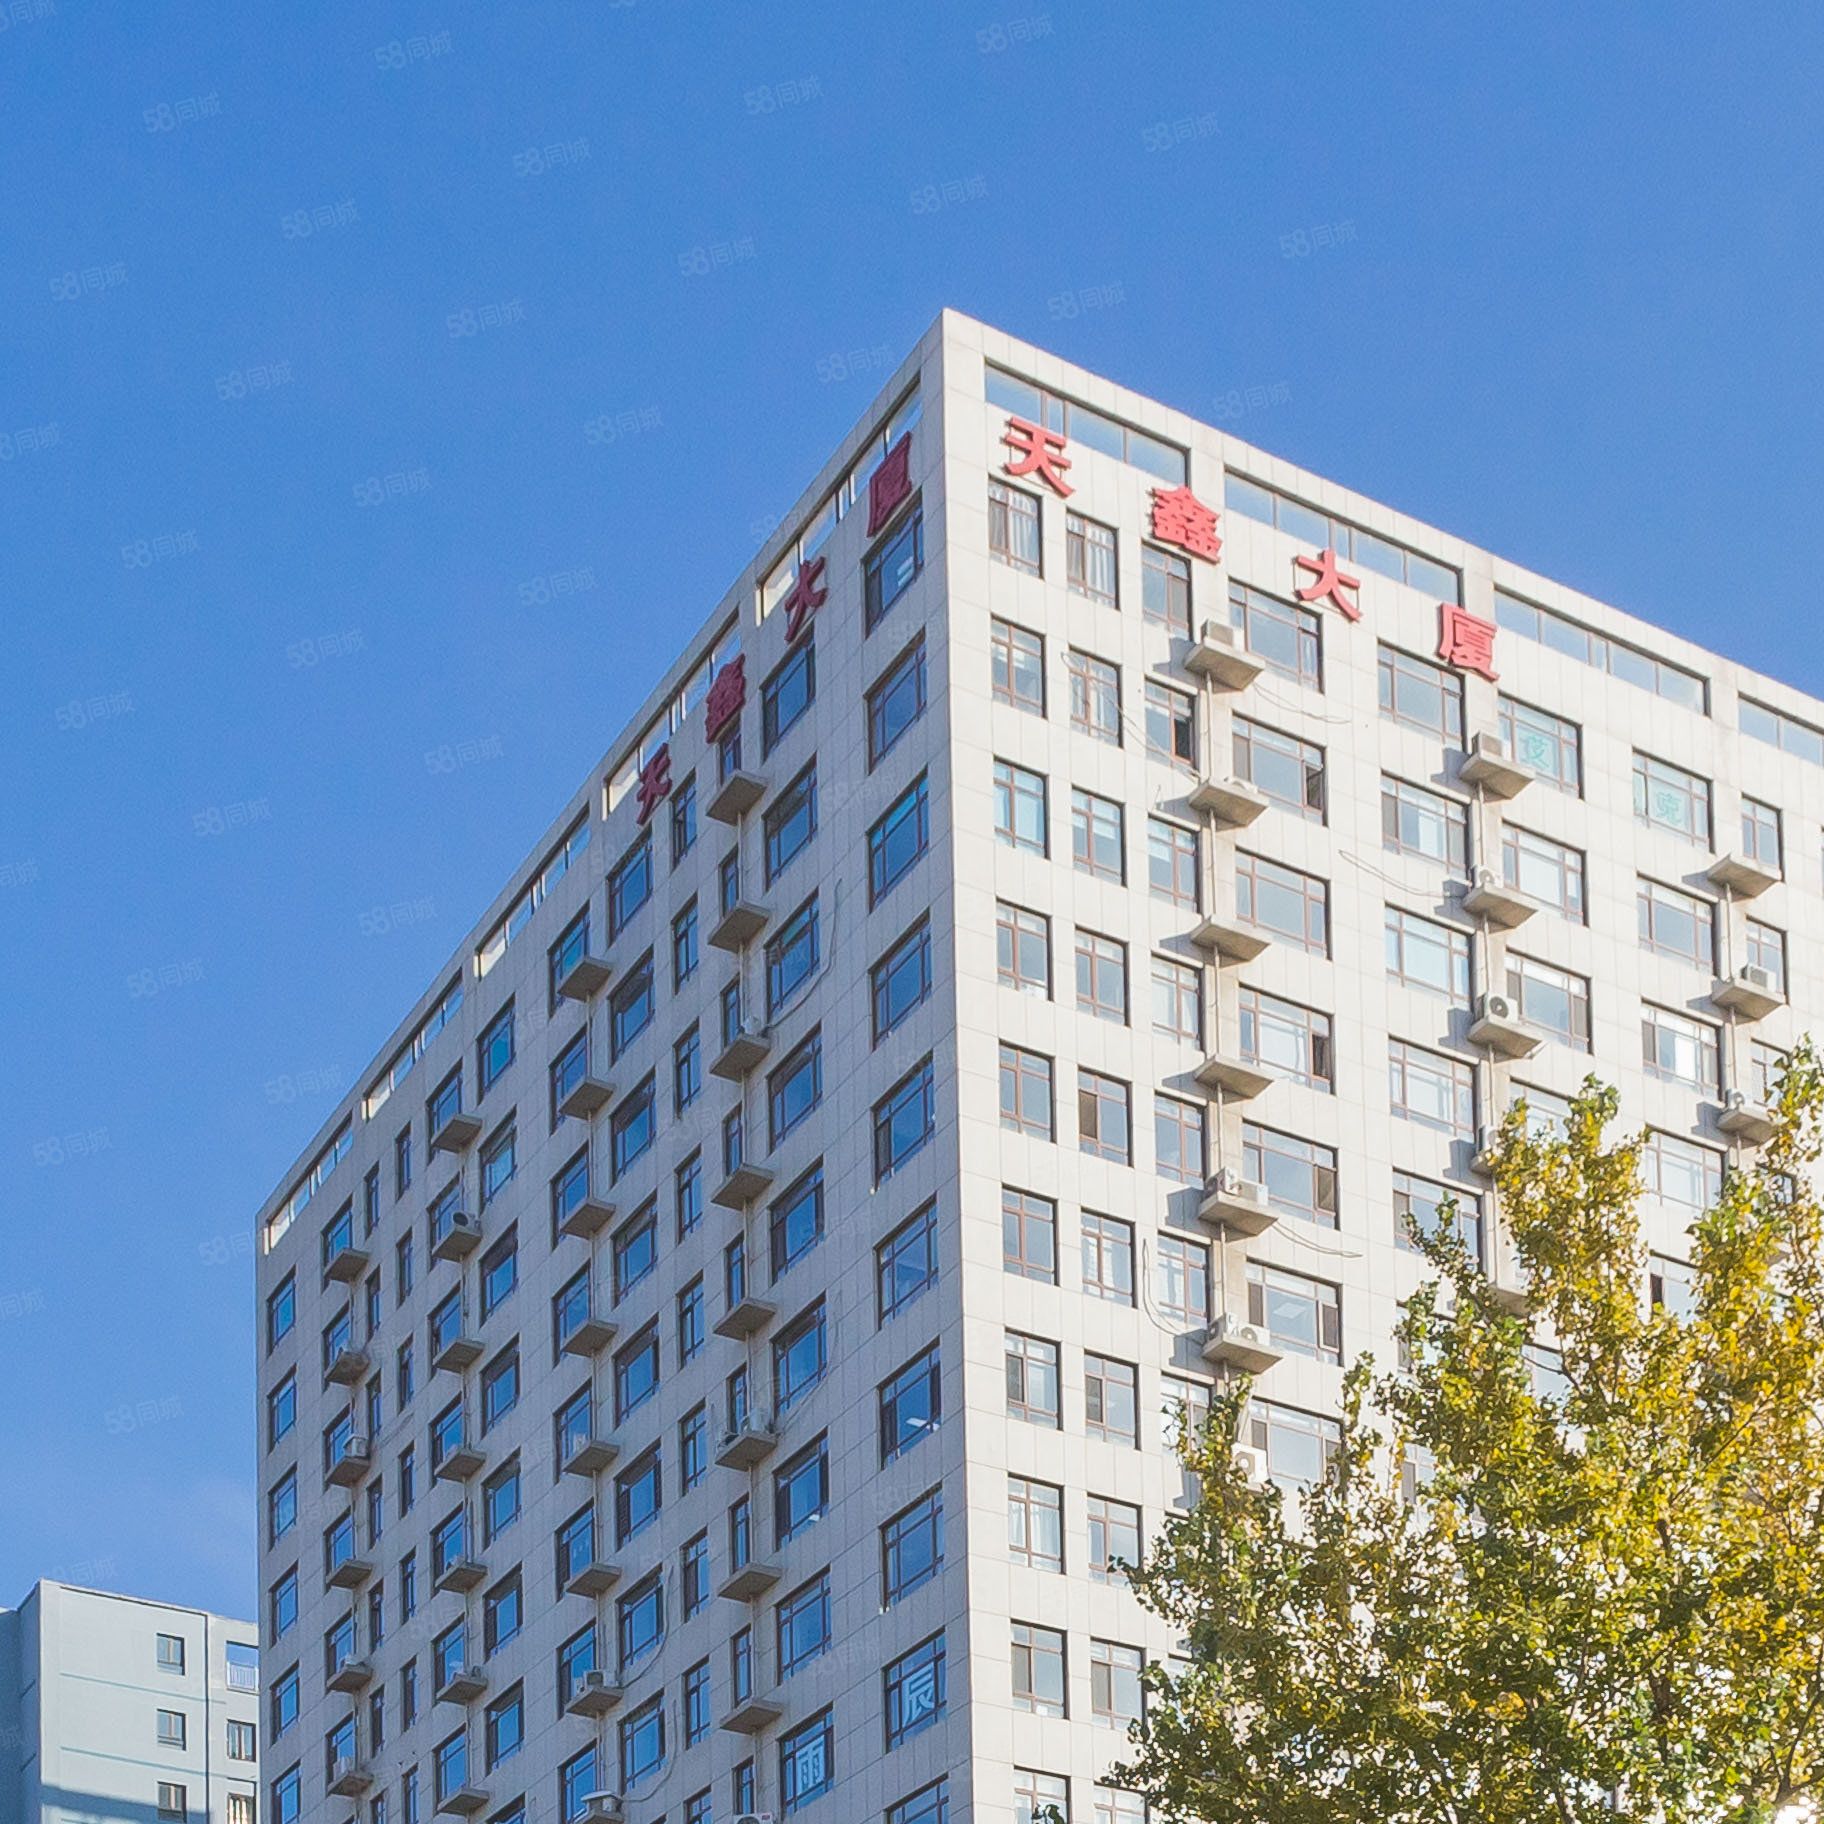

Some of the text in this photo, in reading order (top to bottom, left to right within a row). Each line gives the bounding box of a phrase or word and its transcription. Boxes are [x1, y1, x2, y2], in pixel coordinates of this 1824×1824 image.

[635, 431, 914, 826] 天鑫大厦
[1002, 415, 1501, 683] 天鑫大厦
